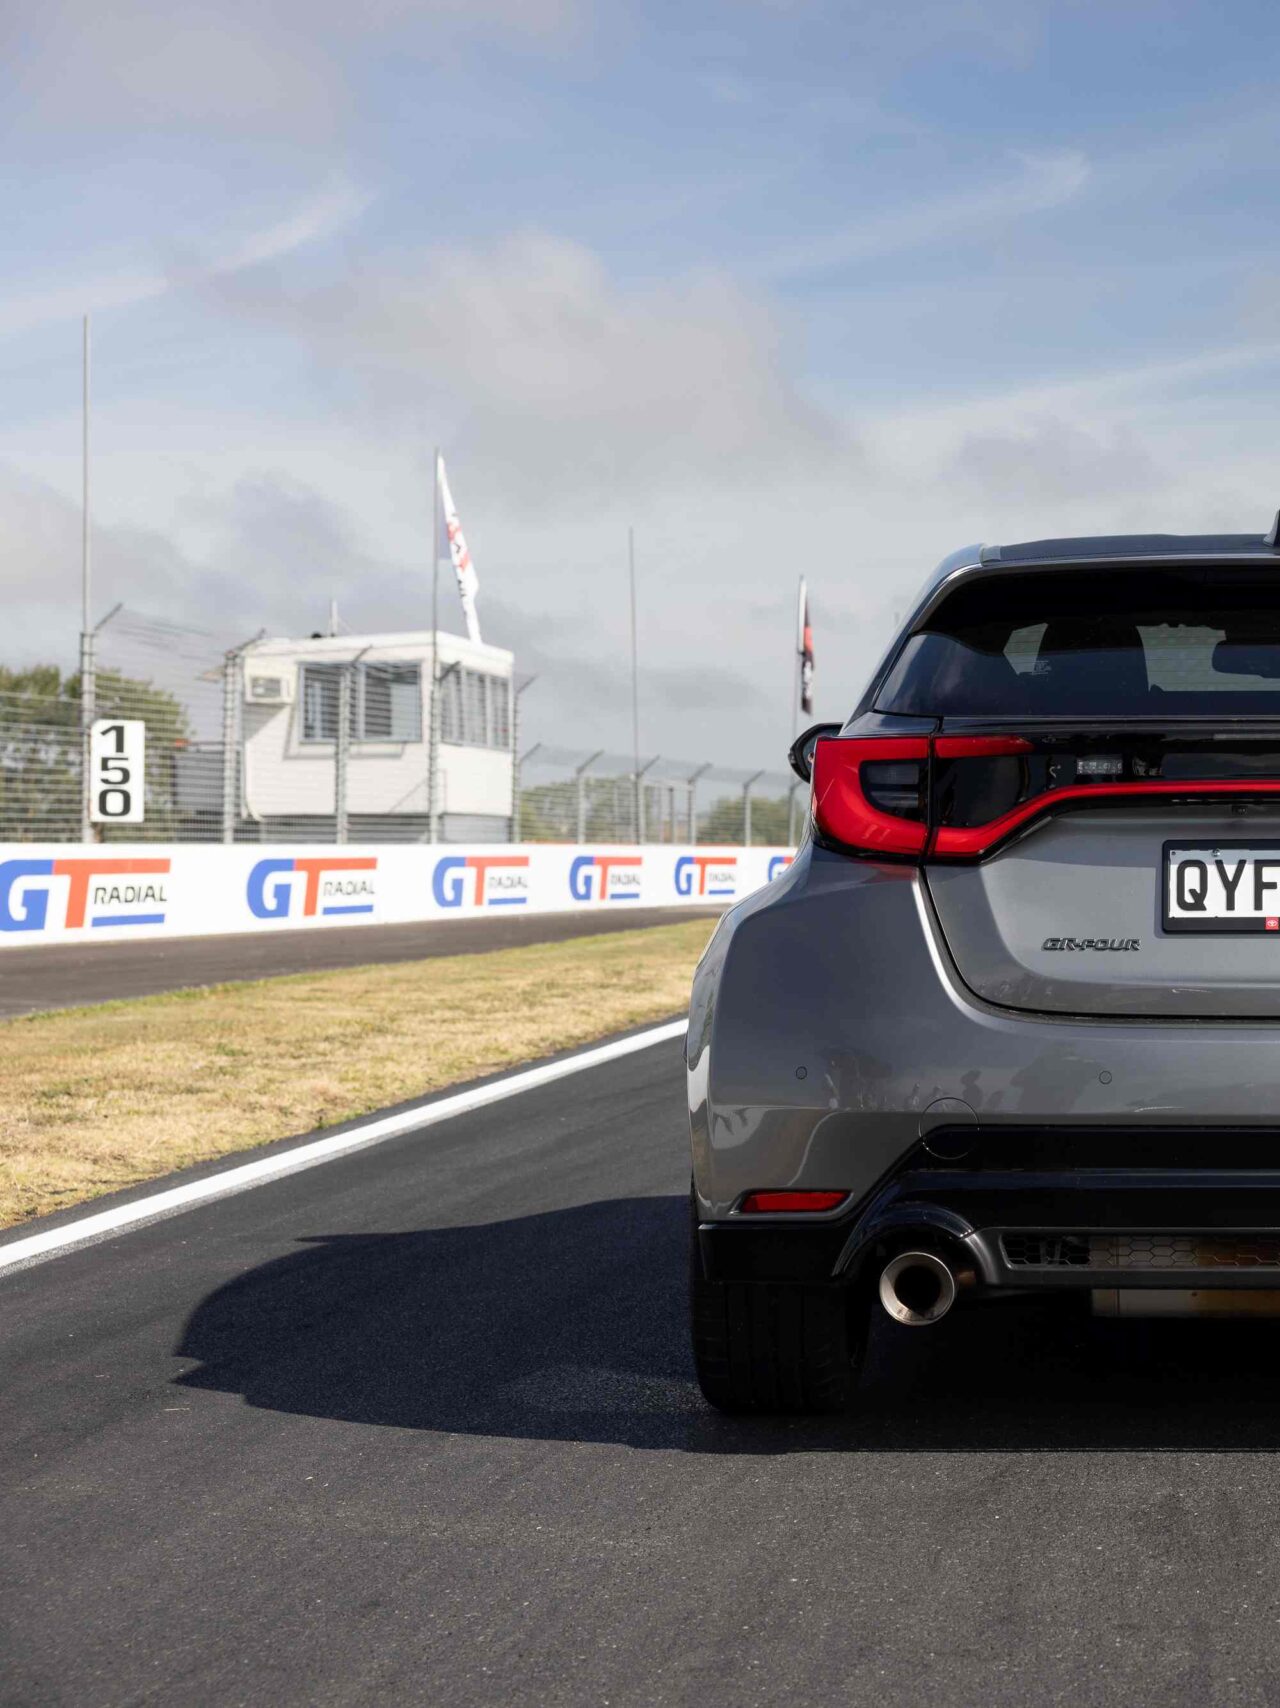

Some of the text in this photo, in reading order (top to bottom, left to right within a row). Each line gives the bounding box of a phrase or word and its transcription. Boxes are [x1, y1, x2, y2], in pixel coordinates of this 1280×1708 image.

[99, 726, 131, 816] 150
[0, 859, 171, 932] GT RADIAL
[246, 858, 378, 919] GT RADIAL
[432, 857, 529, 907] GT
[569, 856, 642, 901] GT
[674, 856, 737, 896] GT
[1042, 938, 1140, 951] GR-FOUR
